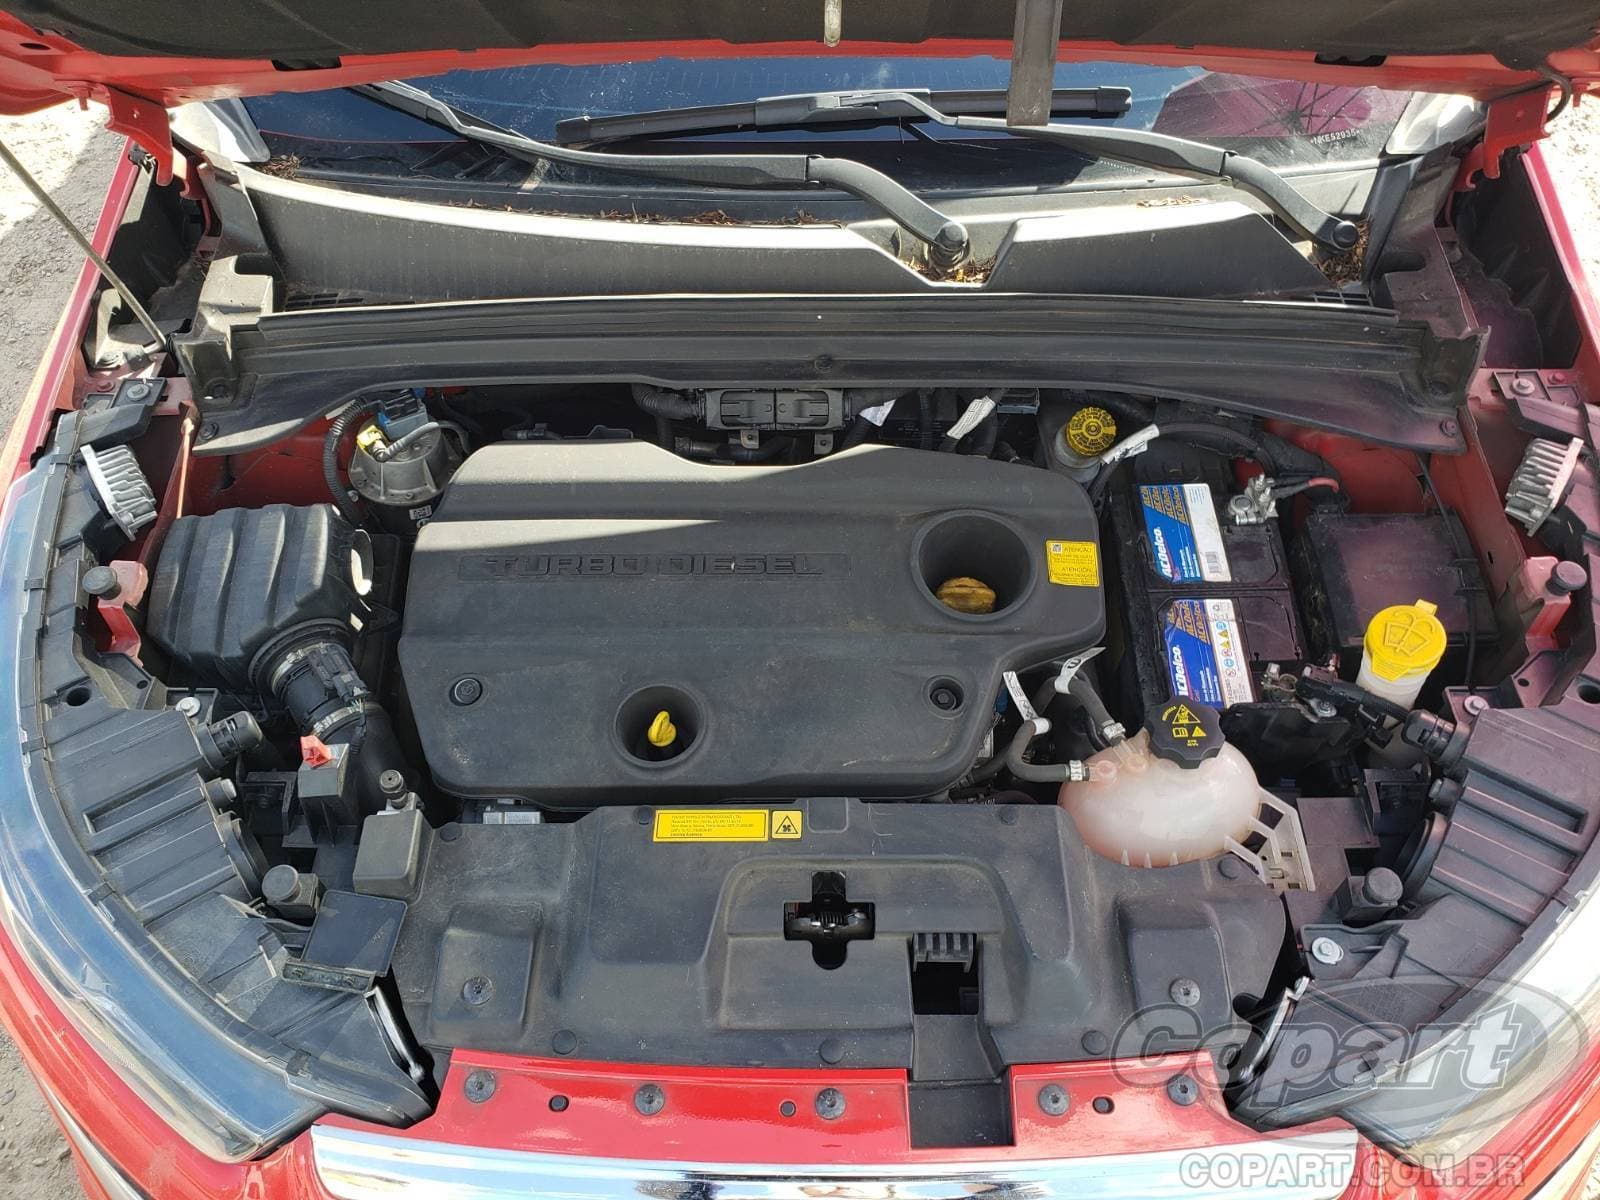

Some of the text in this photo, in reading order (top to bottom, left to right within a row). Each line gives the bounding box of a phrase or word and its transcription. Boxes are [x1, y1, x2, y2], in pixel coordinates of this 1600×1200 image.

[487, 553, 824, 577] TURBO DIESEL
[1153, 528, 1173, 577] ACDelco
